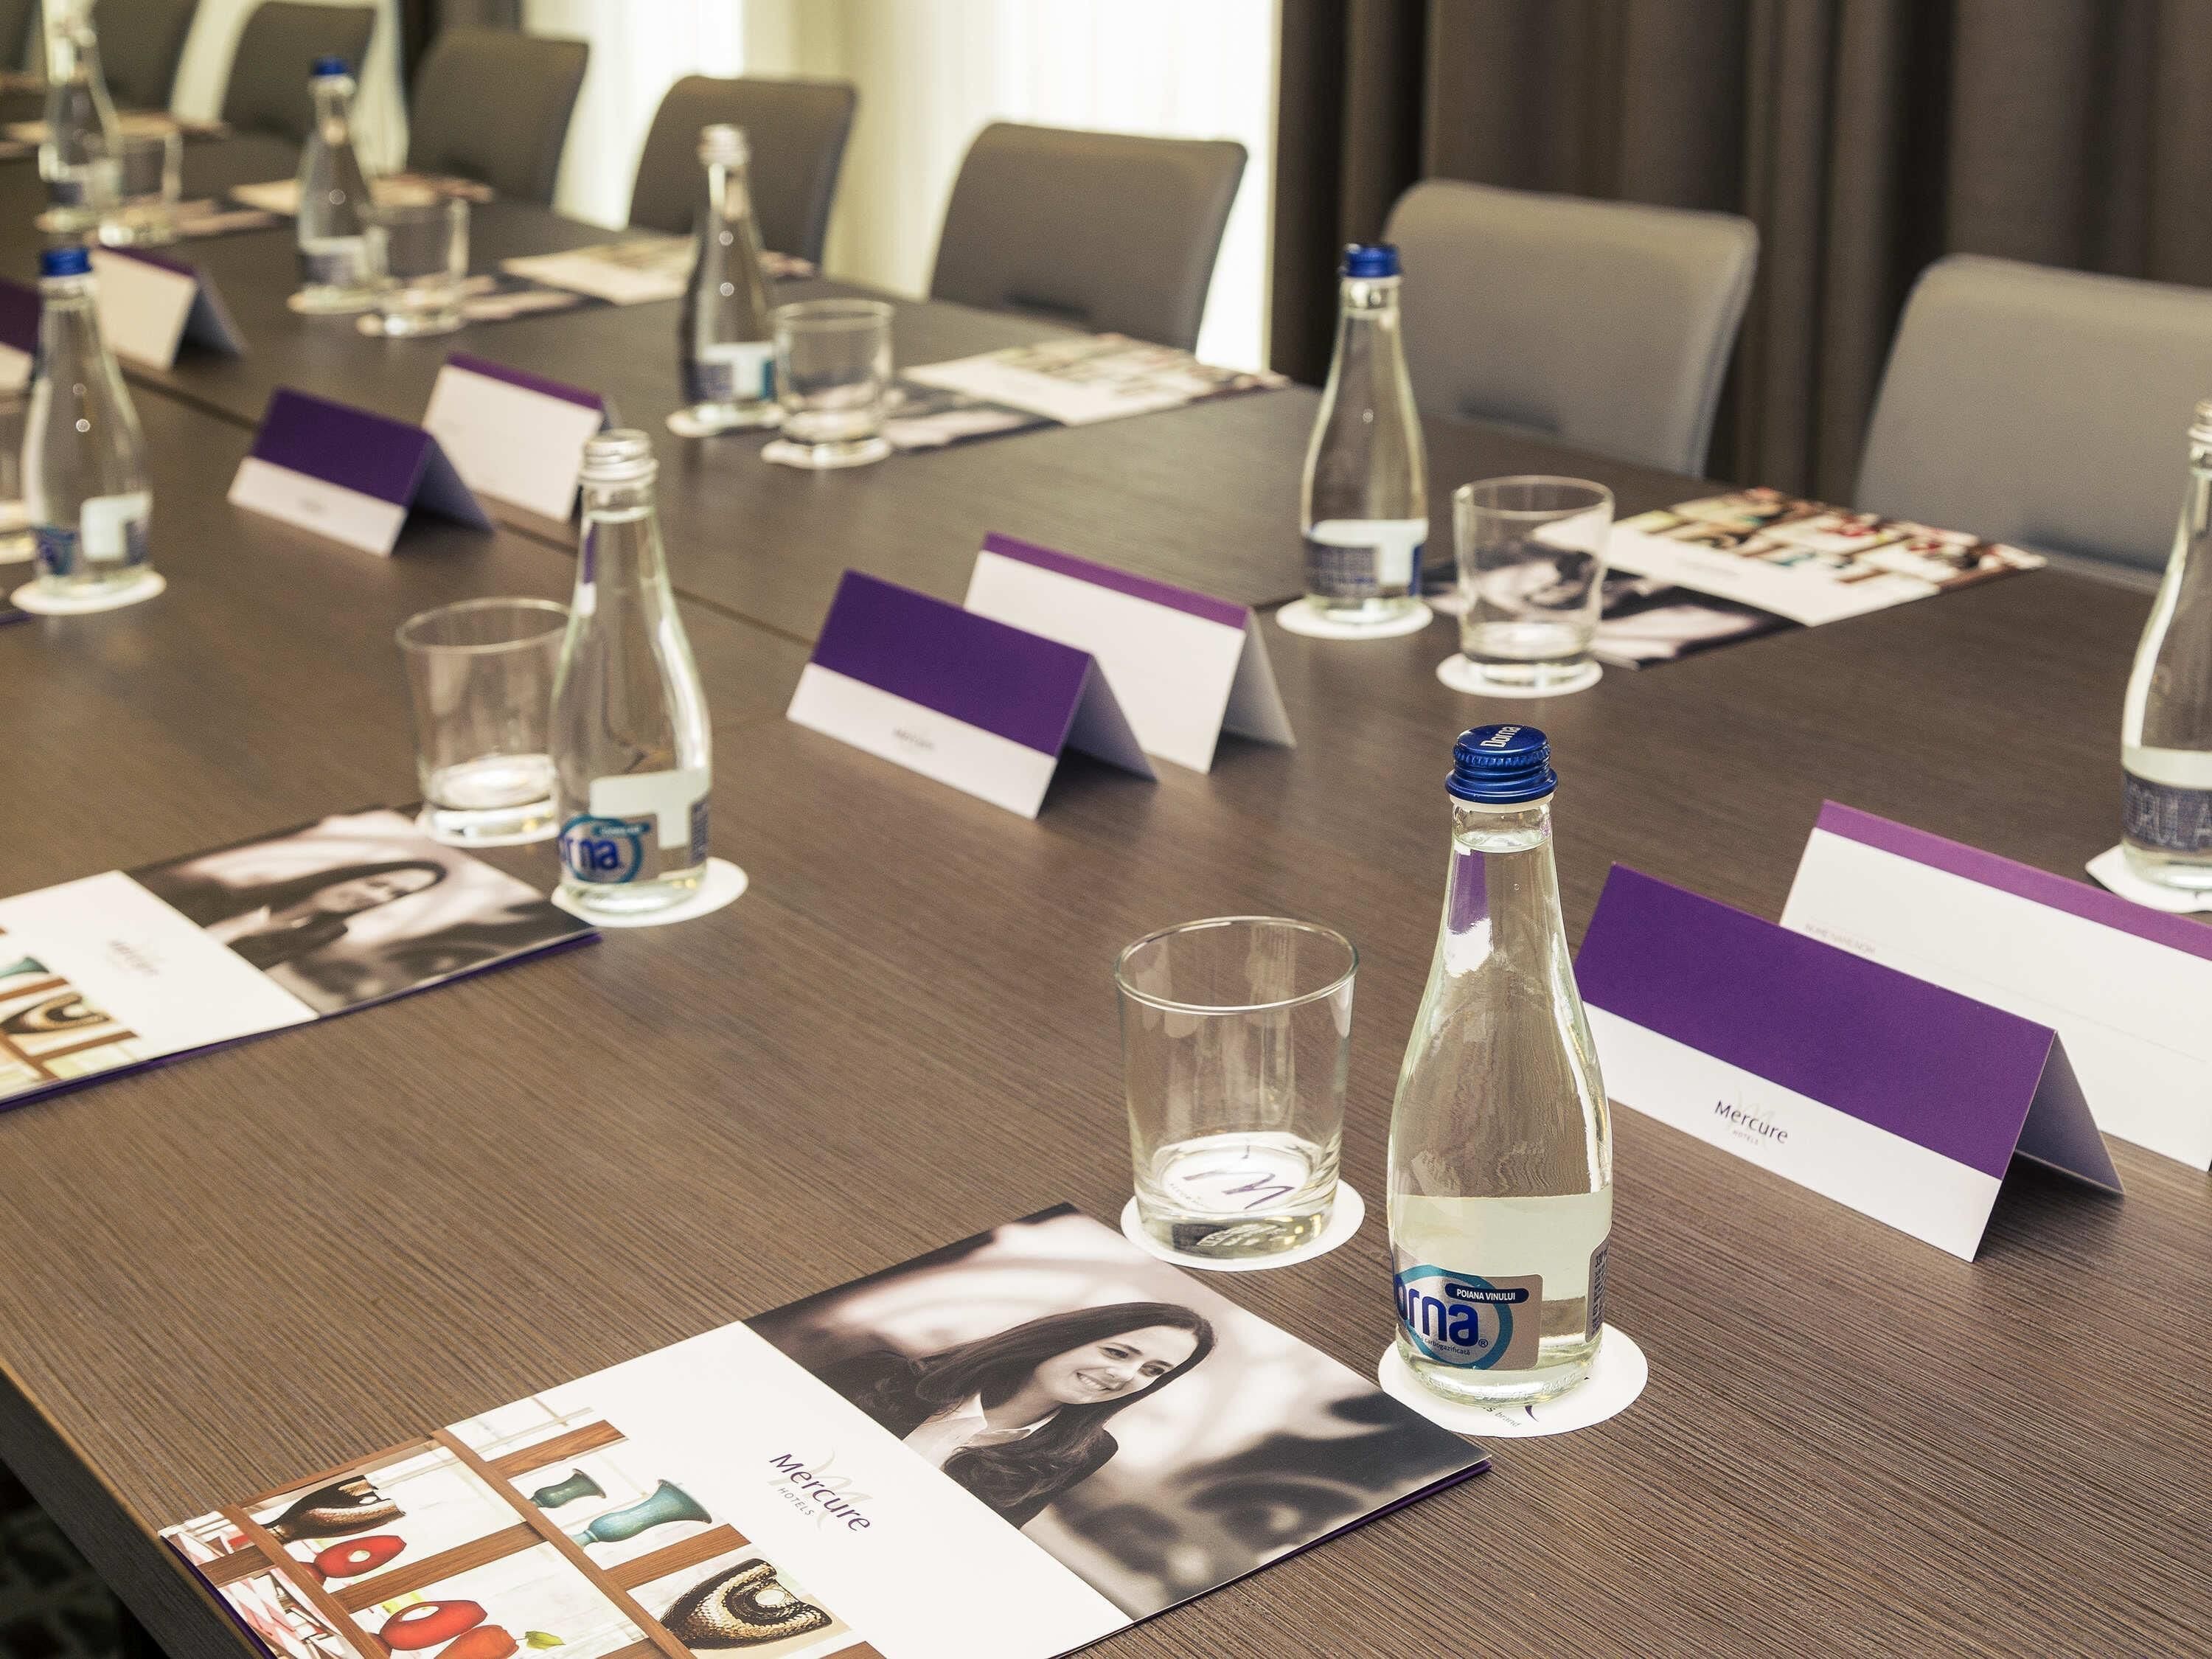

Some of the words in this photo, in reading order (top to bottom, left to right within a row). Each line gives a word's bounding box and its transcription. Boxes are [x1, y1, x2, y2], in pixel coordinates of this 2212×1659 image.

[1480, 726, 1521, 748] Dorna
[1714, 1099, 1789, 1144] Mercure
[1732, 1130, 1759, 1146] HOTELS
[1456, 1288, 1484, 1301] POIANA
[1485, 1292, 1516, 1301] VINULUI
[1394, 1274, 1481, 1348] orna
[768, 1453, 872, 1531] Mercure
[776, 1487, 815, 1517] HOTELS
